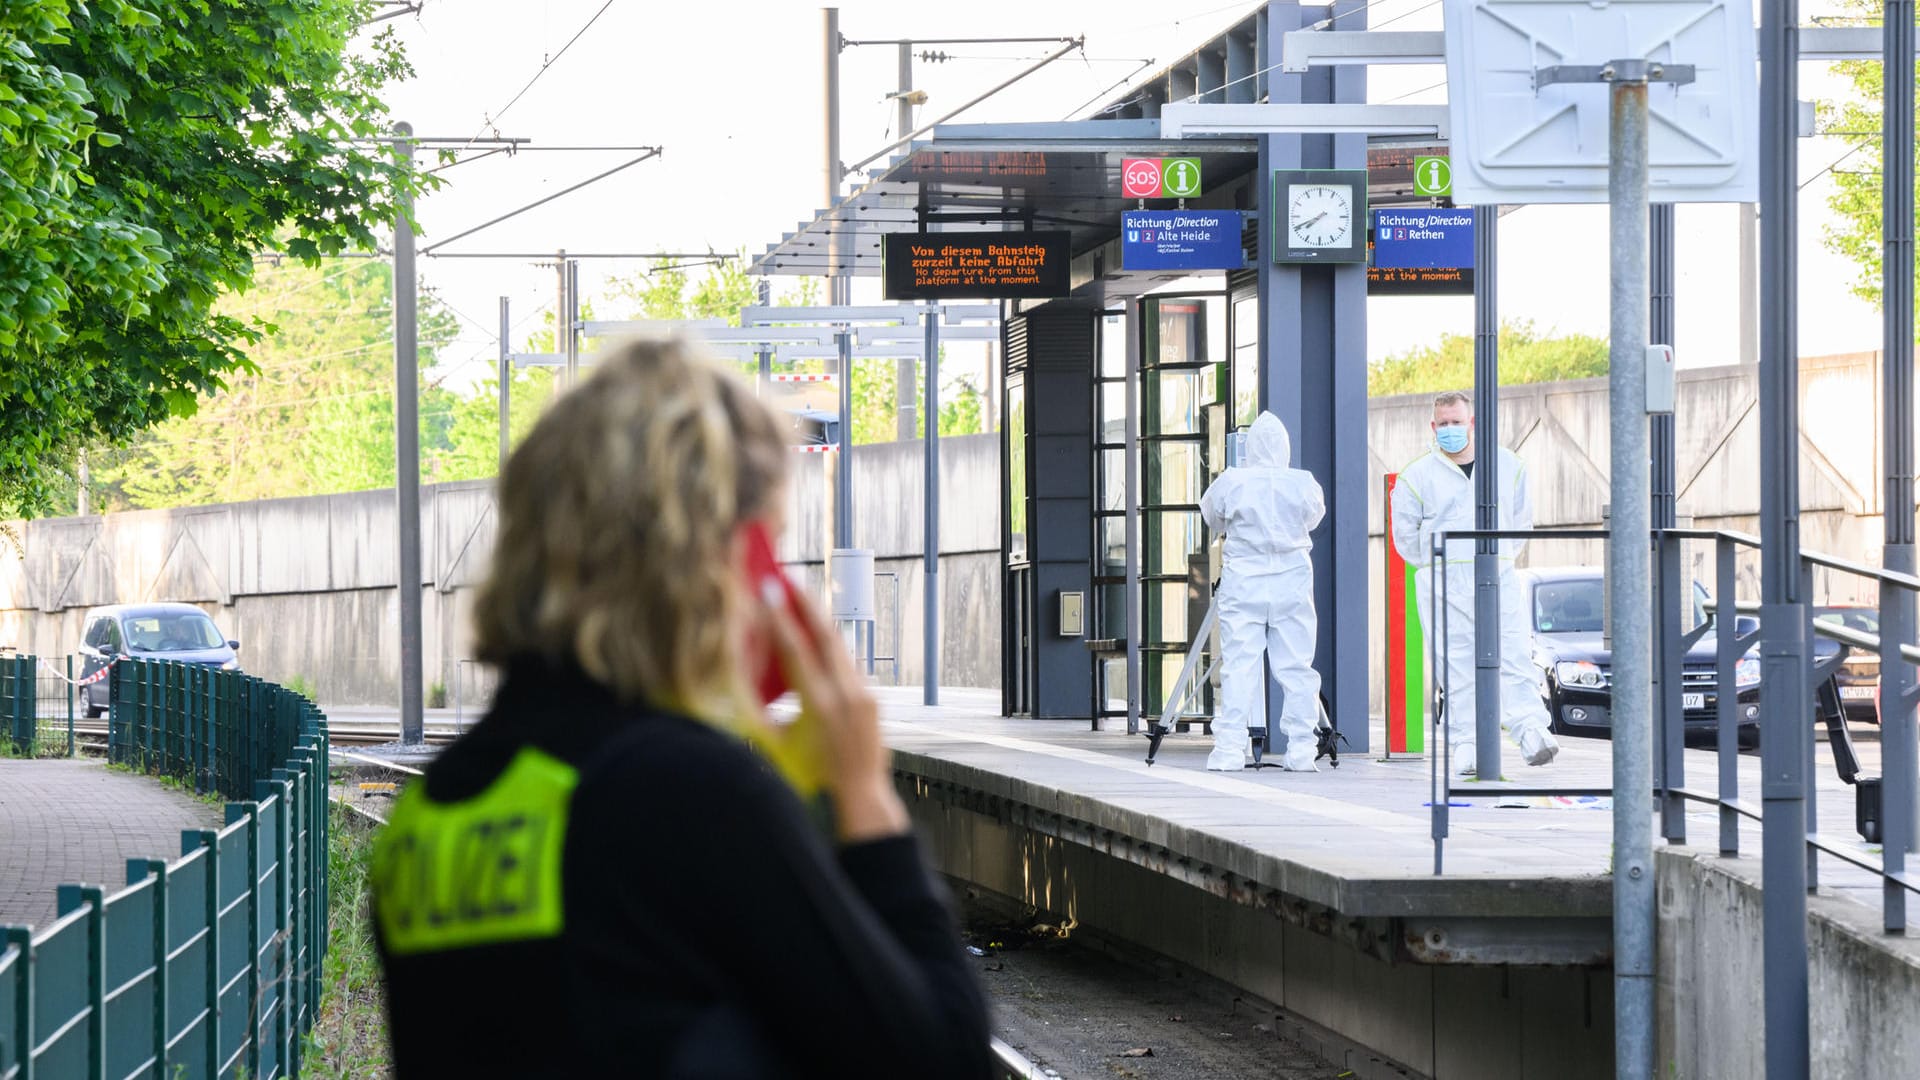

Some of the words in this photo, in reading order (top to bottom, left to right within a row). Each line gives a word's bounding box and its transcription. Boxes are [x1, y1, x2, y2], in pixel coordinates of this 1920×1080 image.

[1128, 171, 1157, 185] SOS
[1129, 231, 1138, 242] U
[1157, 231, 1178, 241] Alte
[1181, 231, 1211, 241] Heide
[1382, 229, 1391, 240] U
[1398, 231, 1404, 239] 2
[1409, 230, 1444, 240] Rethen
[911, 246, 935, 257] Von
[941, 246, 982, 256] diesem
[988, 245, 1046, 257] Bahnsteig
[912, 257, 953, 267] zurzeit
[959, 256, 991, 266] keine
[997, 256, 1045, 266] Abfahrt
[916, 268, 928, 276] No
[933, 267, 984, 278] departure
[988, 267, 1011, 277] from
[1016, 267, 1036, 275] this
[1383, 272, 1395, 281] at
[1400, 272, 1417, 281] the
[1421, 272, 1461, 281] moment
[915, 276, 959, 287] platform
[964, 276, 975, 285] at
[980, 276, 996, 284] the
[1001, 276, 1040, 284] moment
